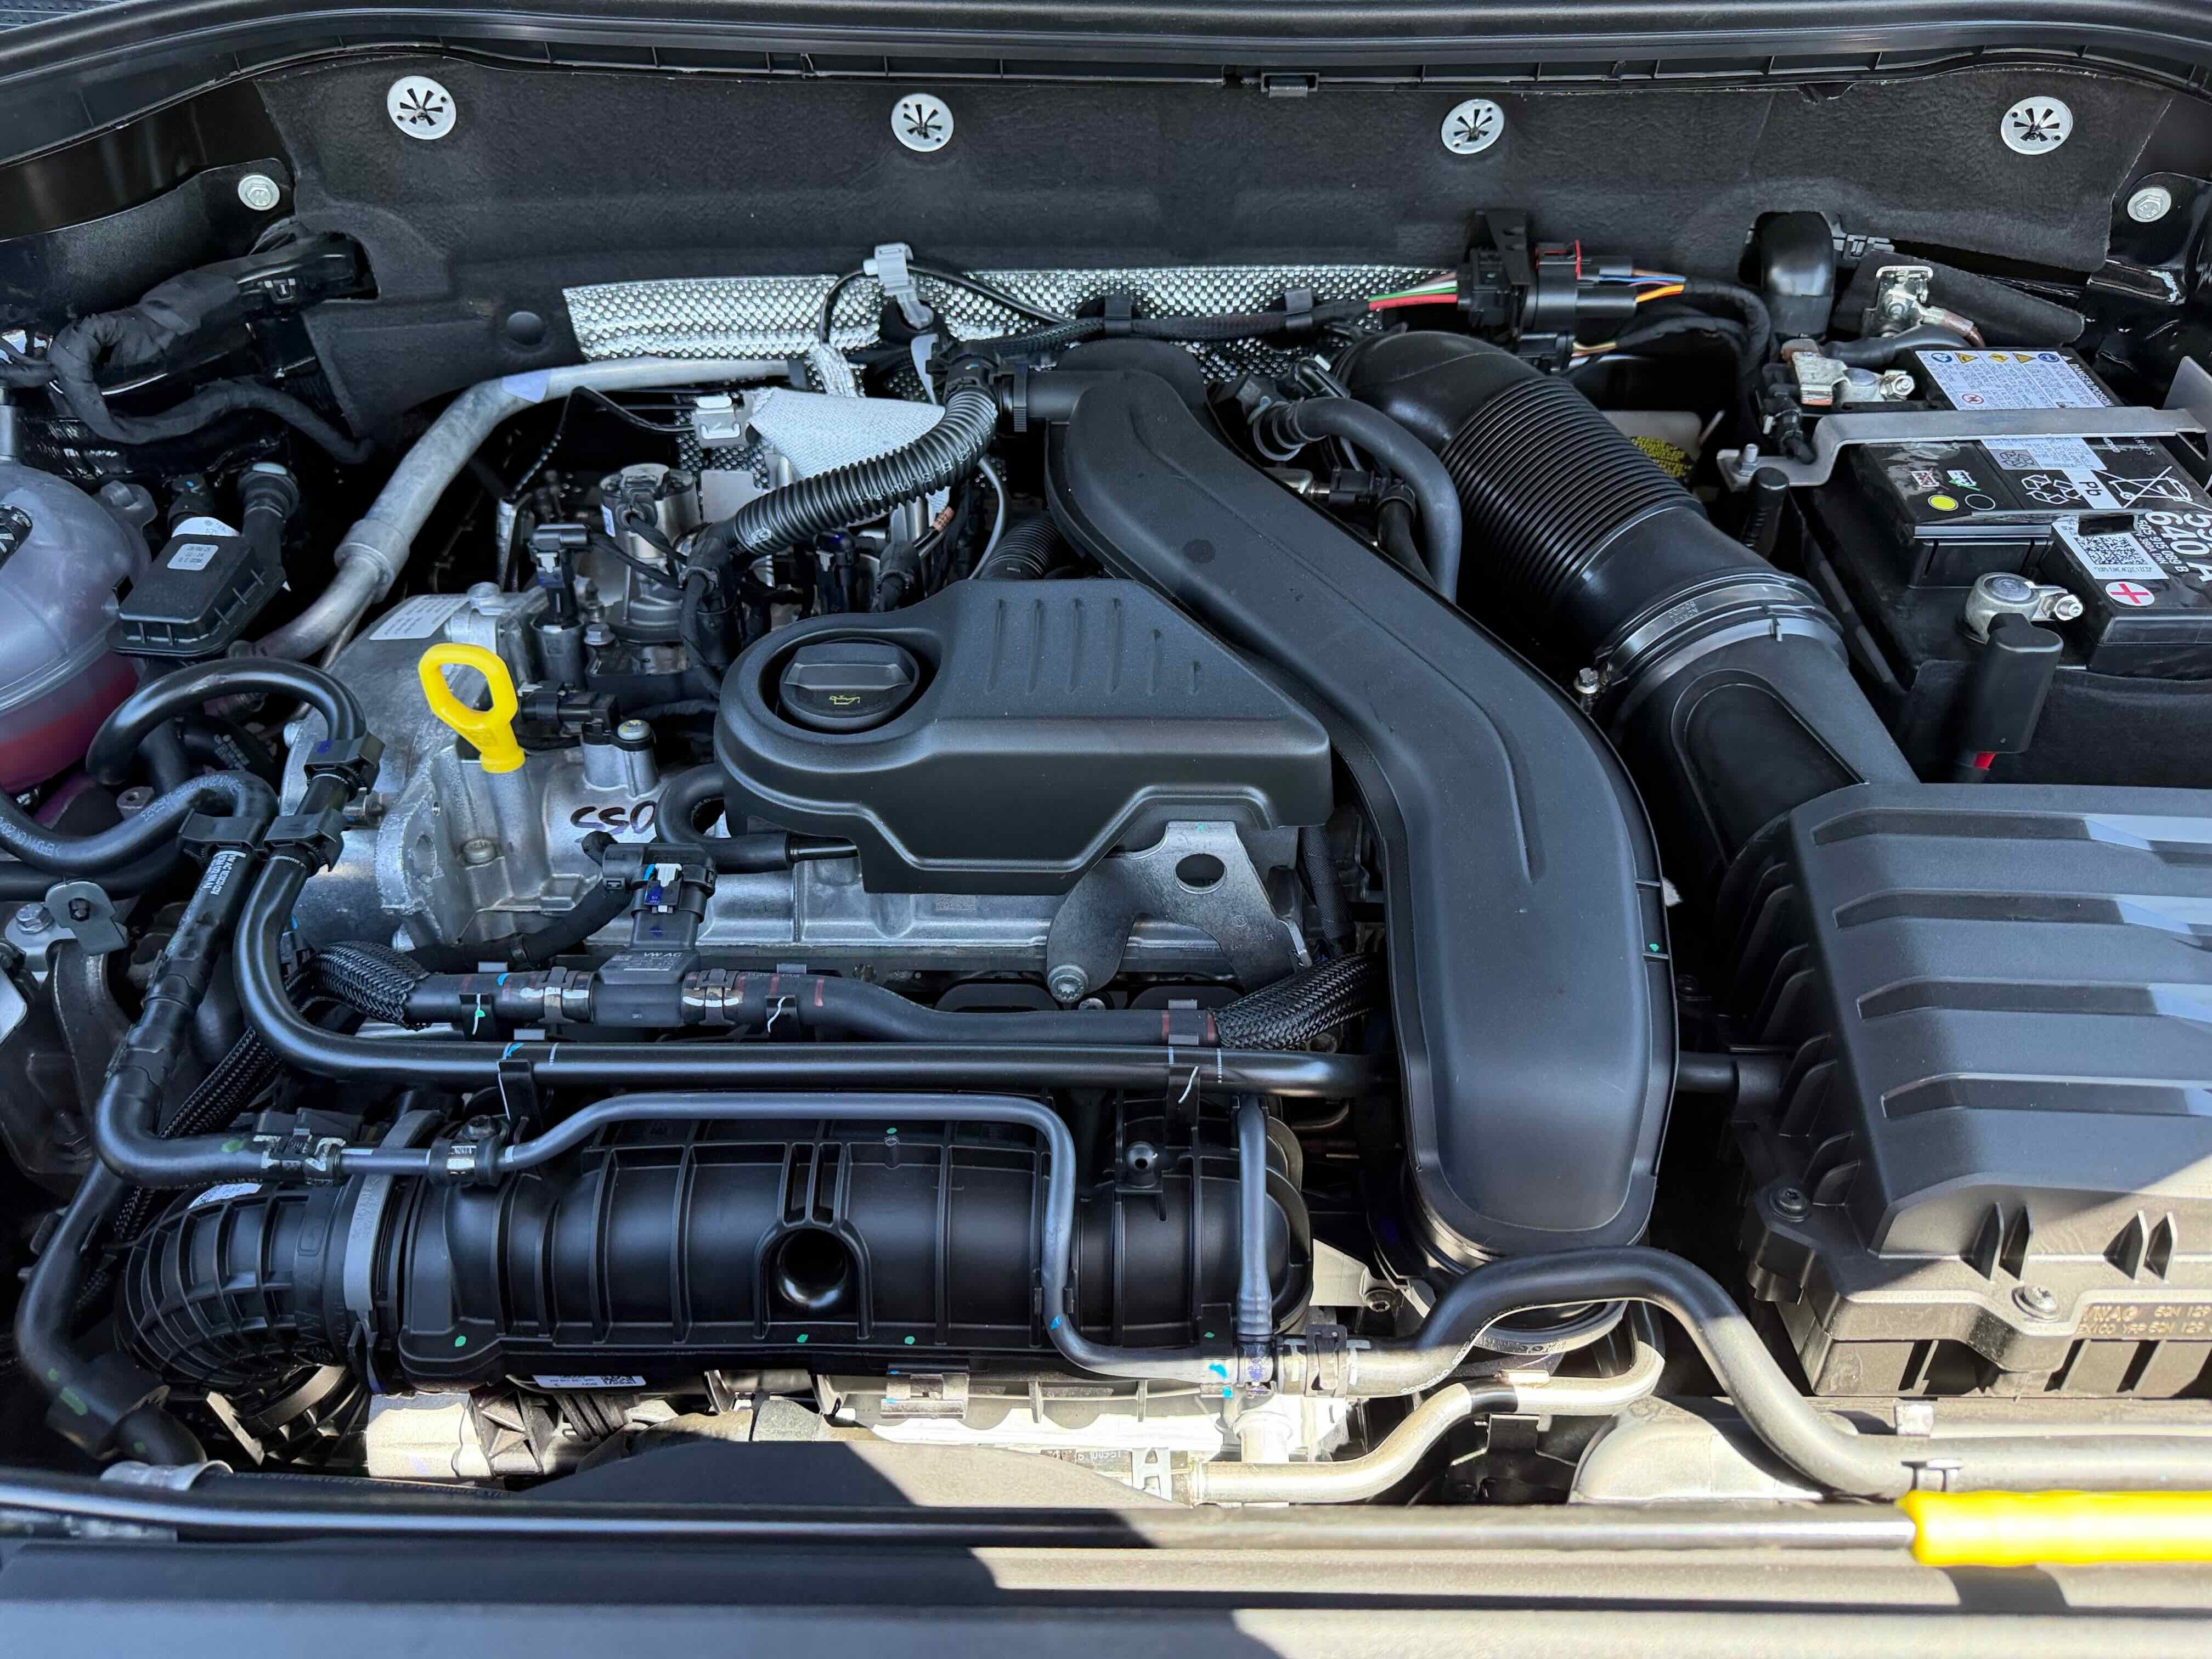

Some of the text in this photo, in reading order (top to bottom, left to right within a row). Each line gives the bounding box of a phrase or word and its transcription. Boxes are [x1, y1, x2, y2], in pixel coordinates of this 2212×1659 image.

[2079, 481, 2102, 496] Pb
[2145, 511, 2210, 555] 640
[2152, 552, 2167, 565] DIN
[2160, 550, 2182, 565] 089
[2077, 1323, 2116, 1335] EXICO
